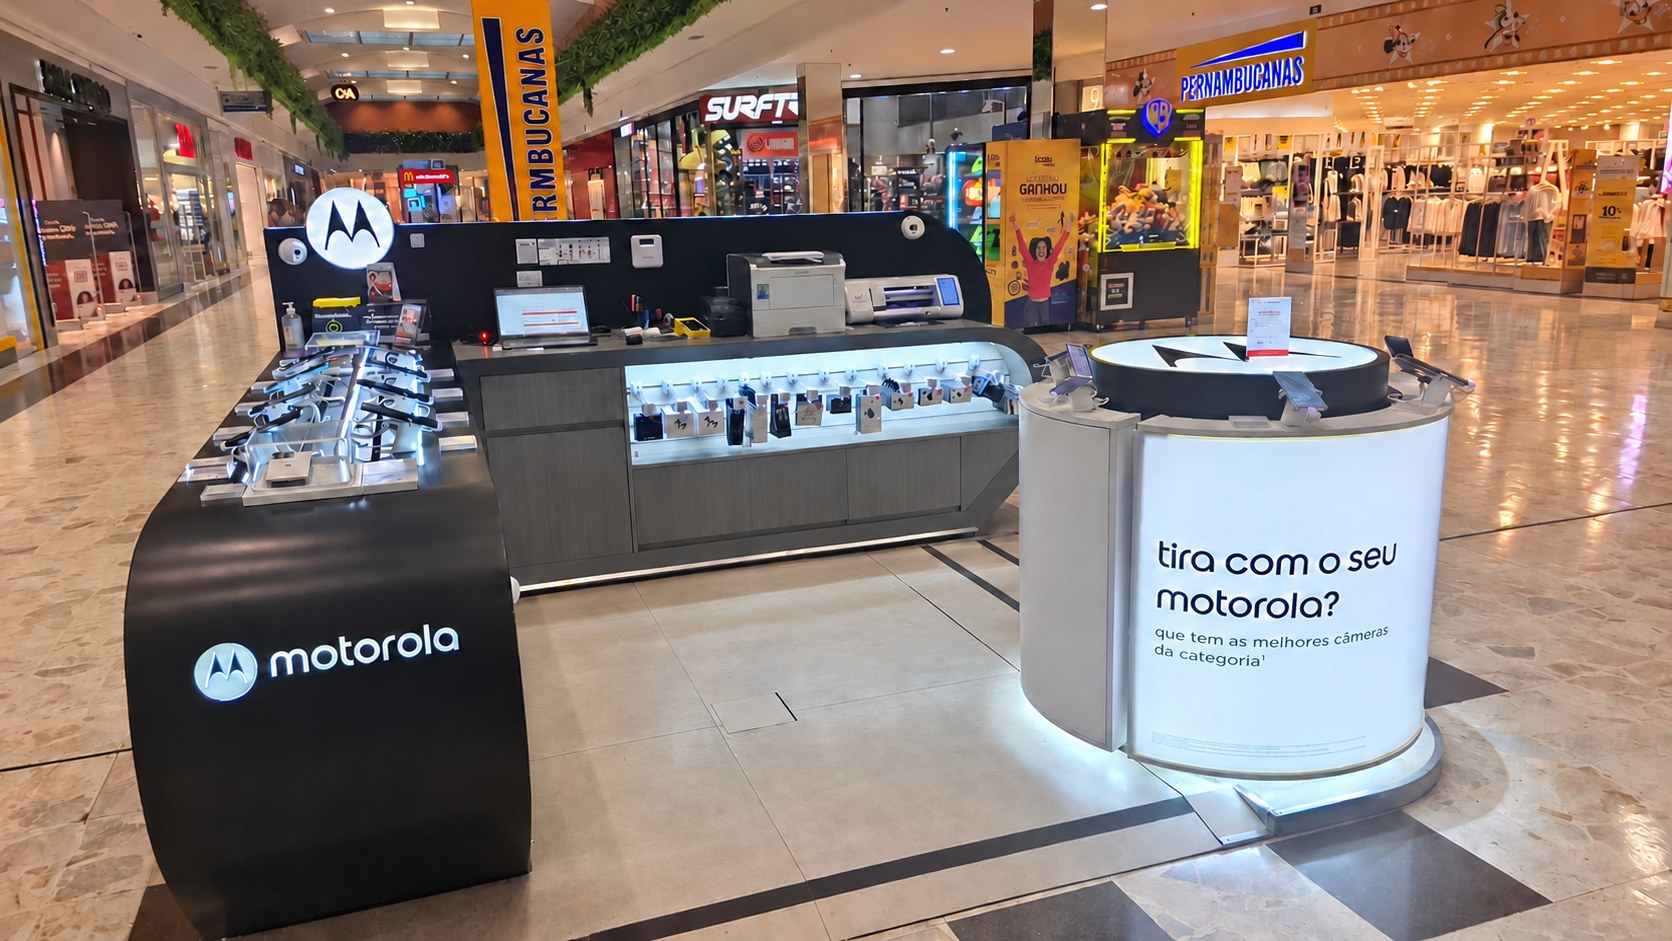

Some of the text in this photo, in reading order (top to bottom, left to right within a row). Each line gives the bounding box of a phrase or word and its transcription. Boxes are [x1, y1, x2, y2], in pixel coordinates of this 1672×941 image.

[335, 87, 356, 100] C&A
[1181, 56, 1305, 102] PERNAMBUCANAS
[515, 27, 560, 221] RMBUCANAS
[1019, 183, 1067, 195] GANHOU
[1158, 540, 1398, 576] tira com o seu
[1156, 588, 1340, 619] motorola?
[269, 623, 460, 678] motorola
[1154, 644, 1174, 658] da
[1155, 625, 1389, 649] que tem as melhores câmeras
